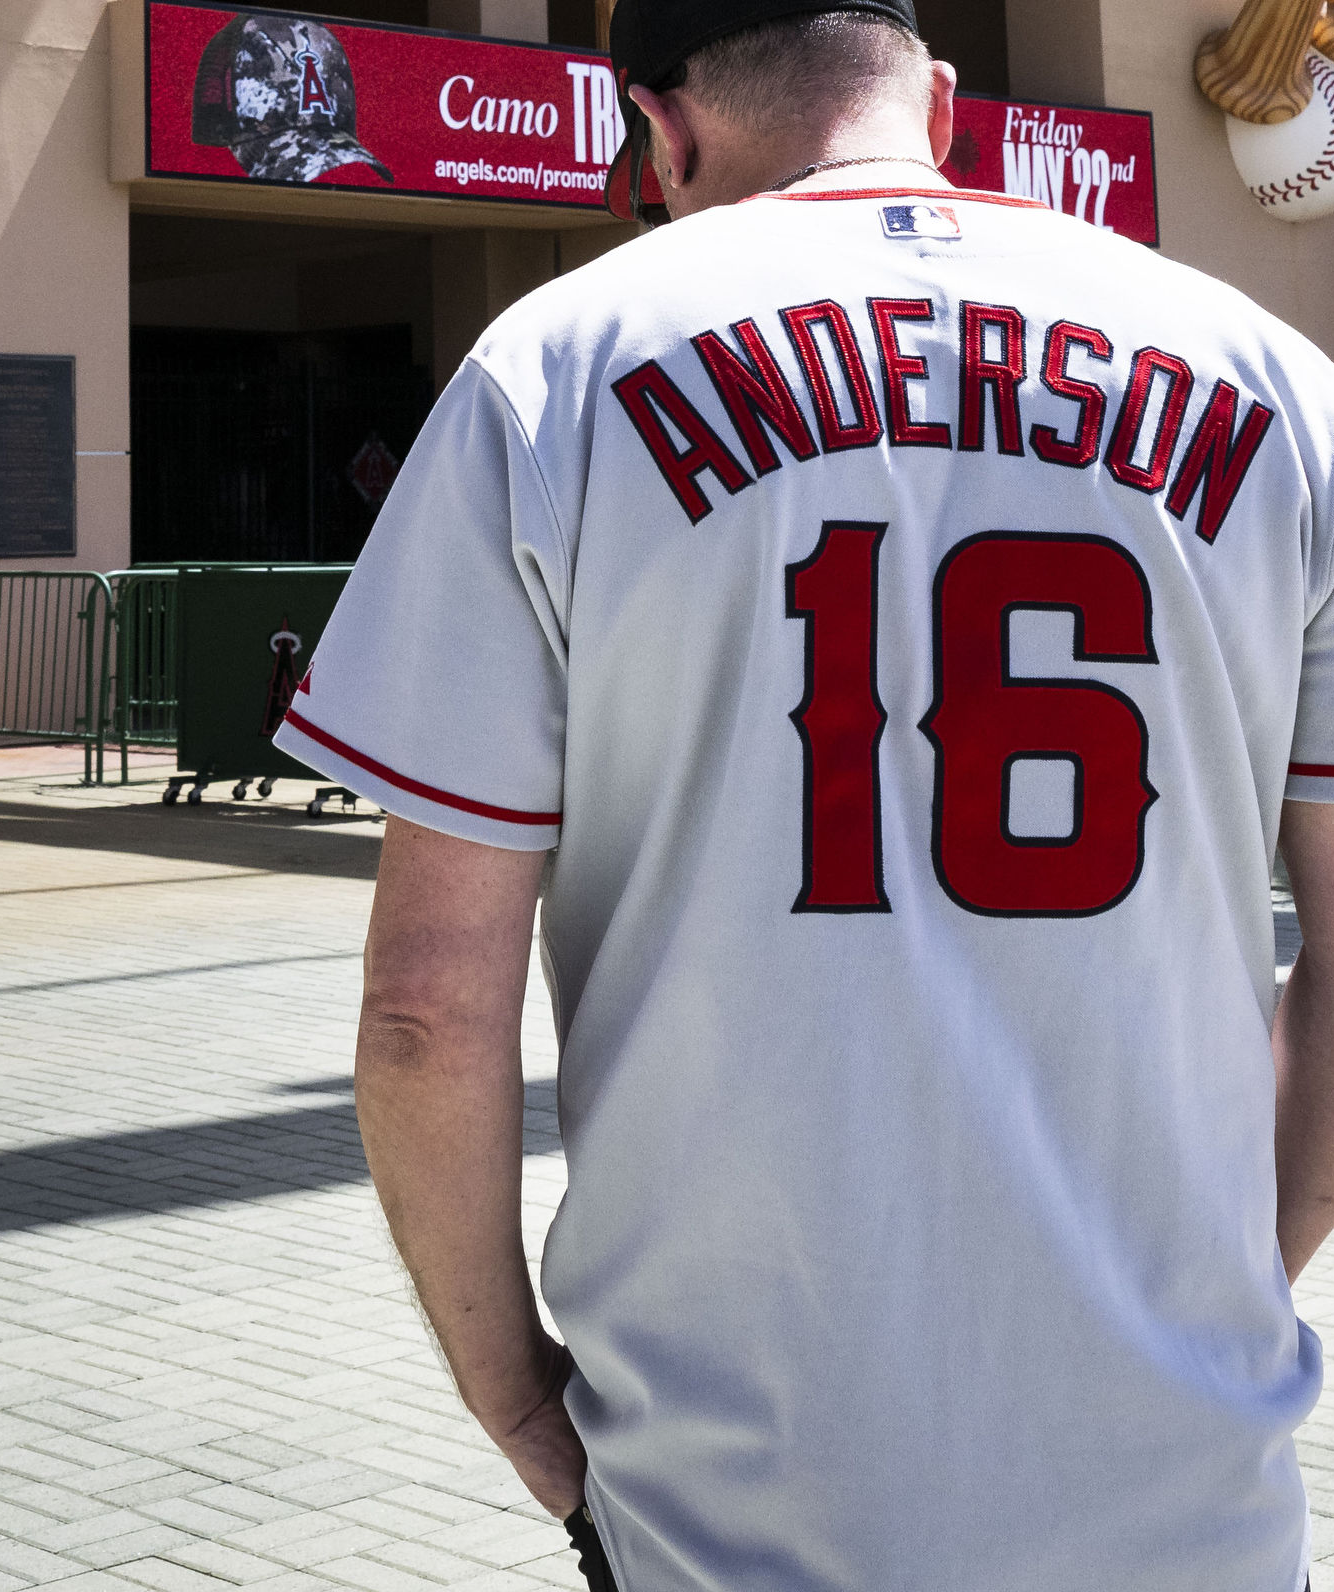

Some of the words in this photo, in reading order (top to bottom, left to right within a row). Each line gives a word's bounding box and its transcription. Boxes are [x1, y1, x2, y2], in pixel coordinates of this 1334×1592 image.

[438, 74, 559, 139] Camo
[1002, 105, 1084, 157] Friday
[609, 296, 1276, 546] ANDERSON
[784, 519, 1161, 919] 16
